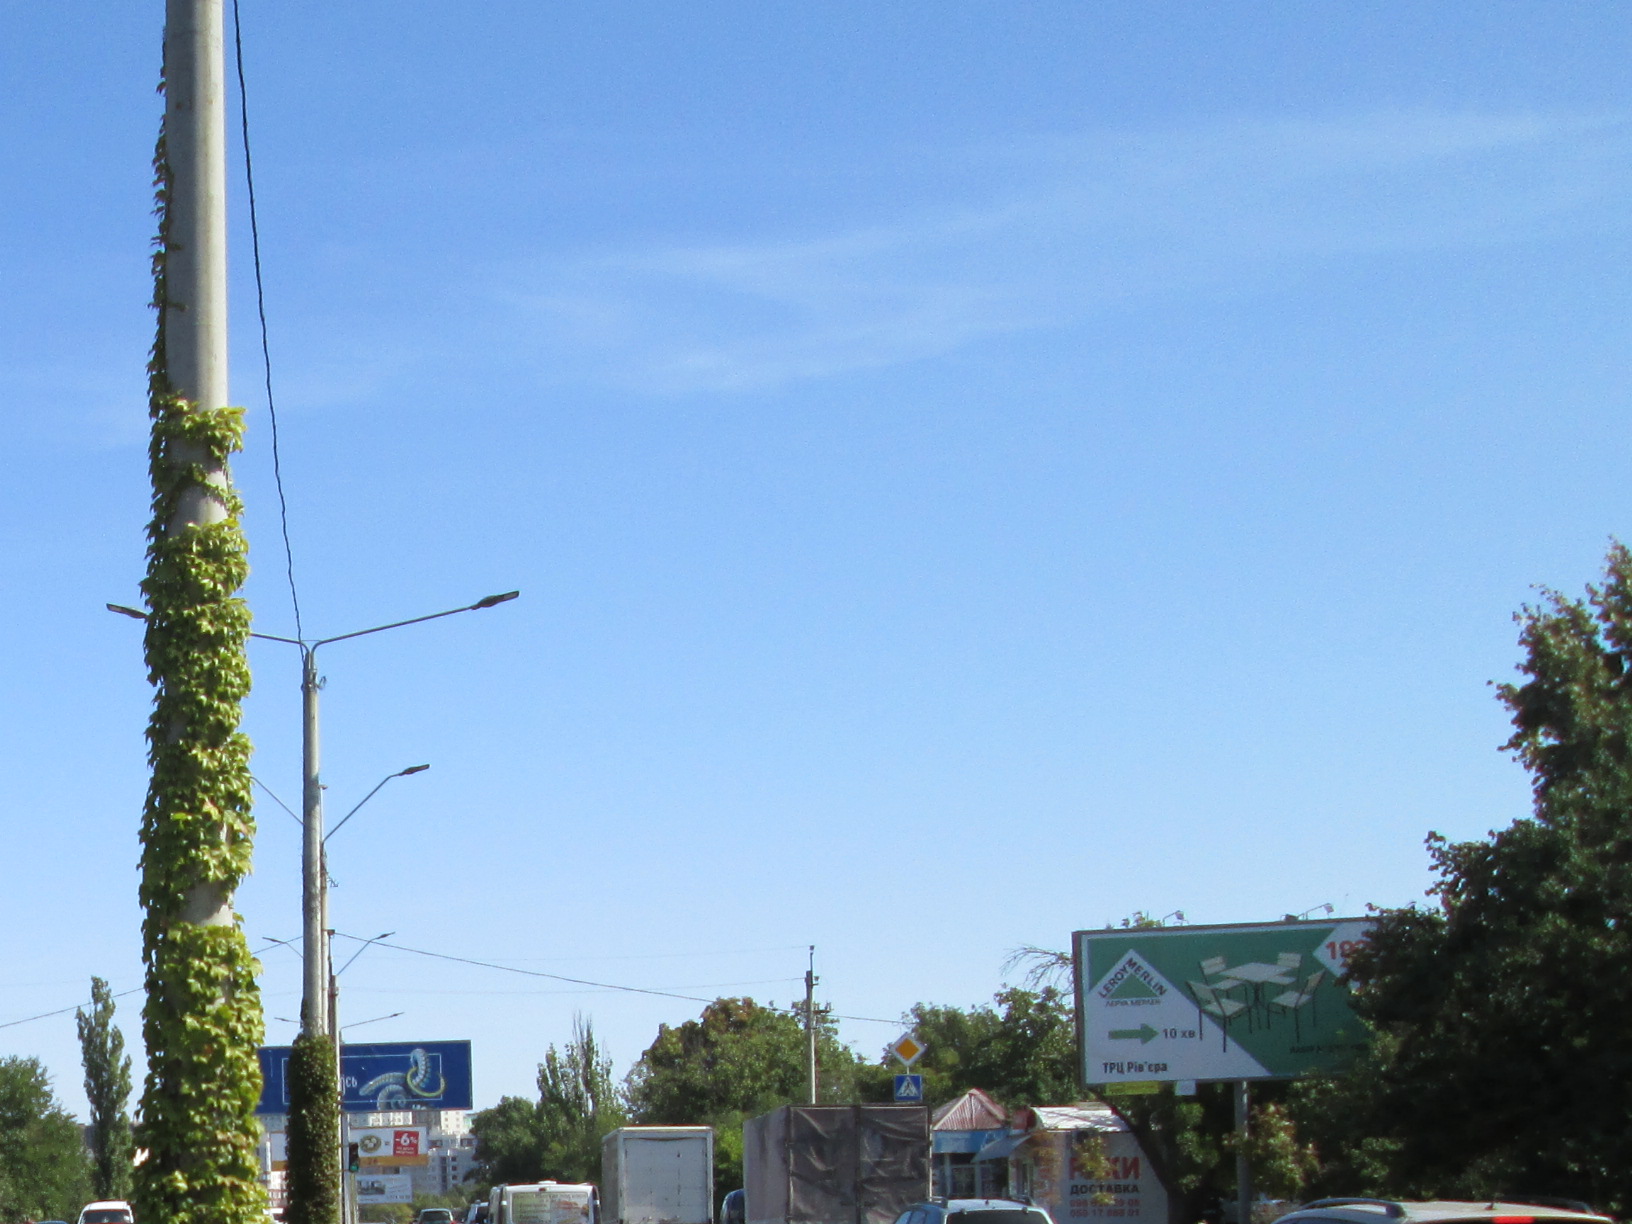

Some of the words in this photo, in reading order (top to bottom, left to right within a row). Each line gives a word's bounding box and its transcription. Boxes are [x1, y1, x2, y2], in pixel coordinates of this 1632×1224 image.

[1097, 963, 1130, 998] LEROY
[1125, 957, 1168, 996] MERLIN
[1163, 1028, 1177, 1039] 10
[1180, 1030, 1196, 1039] хв
[1103, 1062, 1125, 1075] ТРЦ
[1070, 1184, 1139, 1195] ДОСТАВКА
